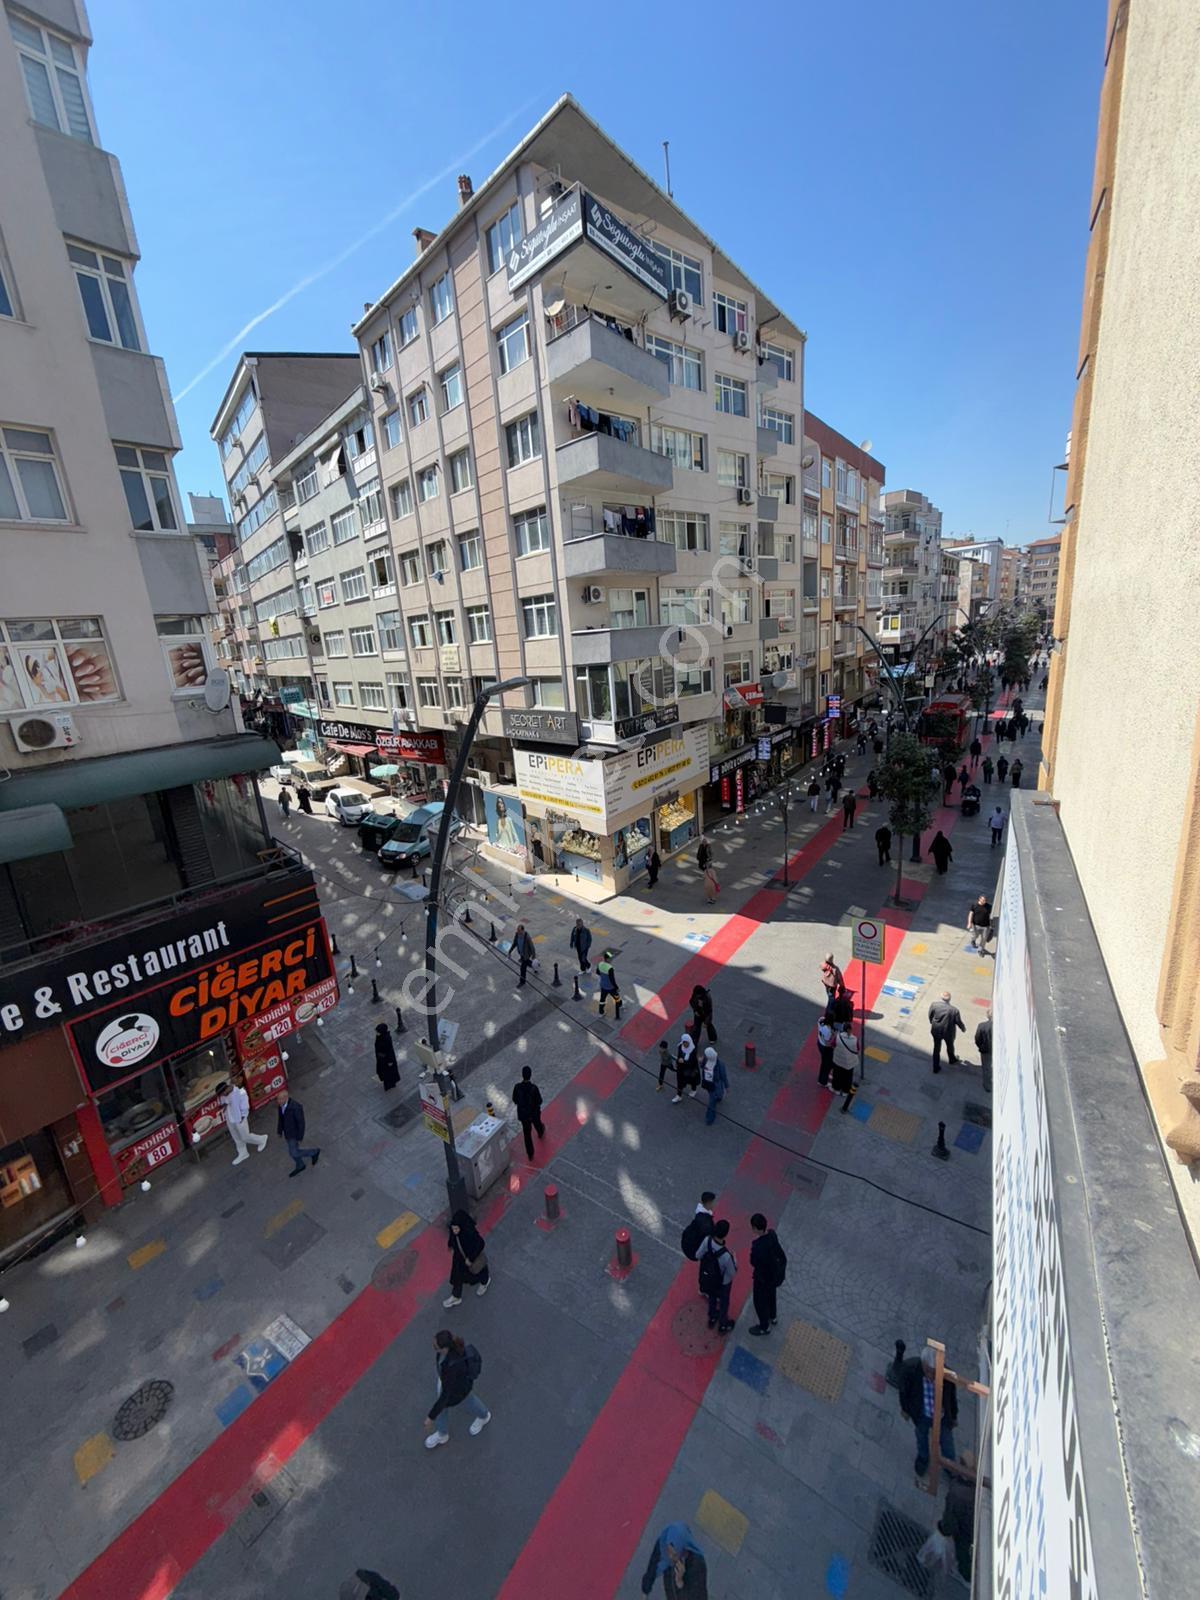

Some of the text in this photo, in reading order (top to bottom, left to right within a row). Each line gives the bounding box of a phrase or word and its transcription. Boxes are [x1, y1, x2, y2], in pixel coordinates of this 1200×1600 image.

[320, 722, 339, 737] Cafe
[339, 724, 350, 738] De
[546, 713, 568, 731] ART
[375, 735, 400, 748] ÖZGÜR
[34, 986, 62, 1019] &
[67, 921, 231, 1006] Restaurant
[169, 927, 316, 1018] CİĞERCİ
[304, 978, 336, 1002] İNDİRİM
[200, 969, 307, 1039] DİYAR
[322, 996, 334, 1009] 120
[254, 1001, 291, 1028] İNDİRİM
[274, 1021, 290, 1035] 120
[121, 1040, 150, 1057] DİYAR
[133, 1124, 175, 1155] İNDİRİM
[153, 1146, 168, 1161] 80
